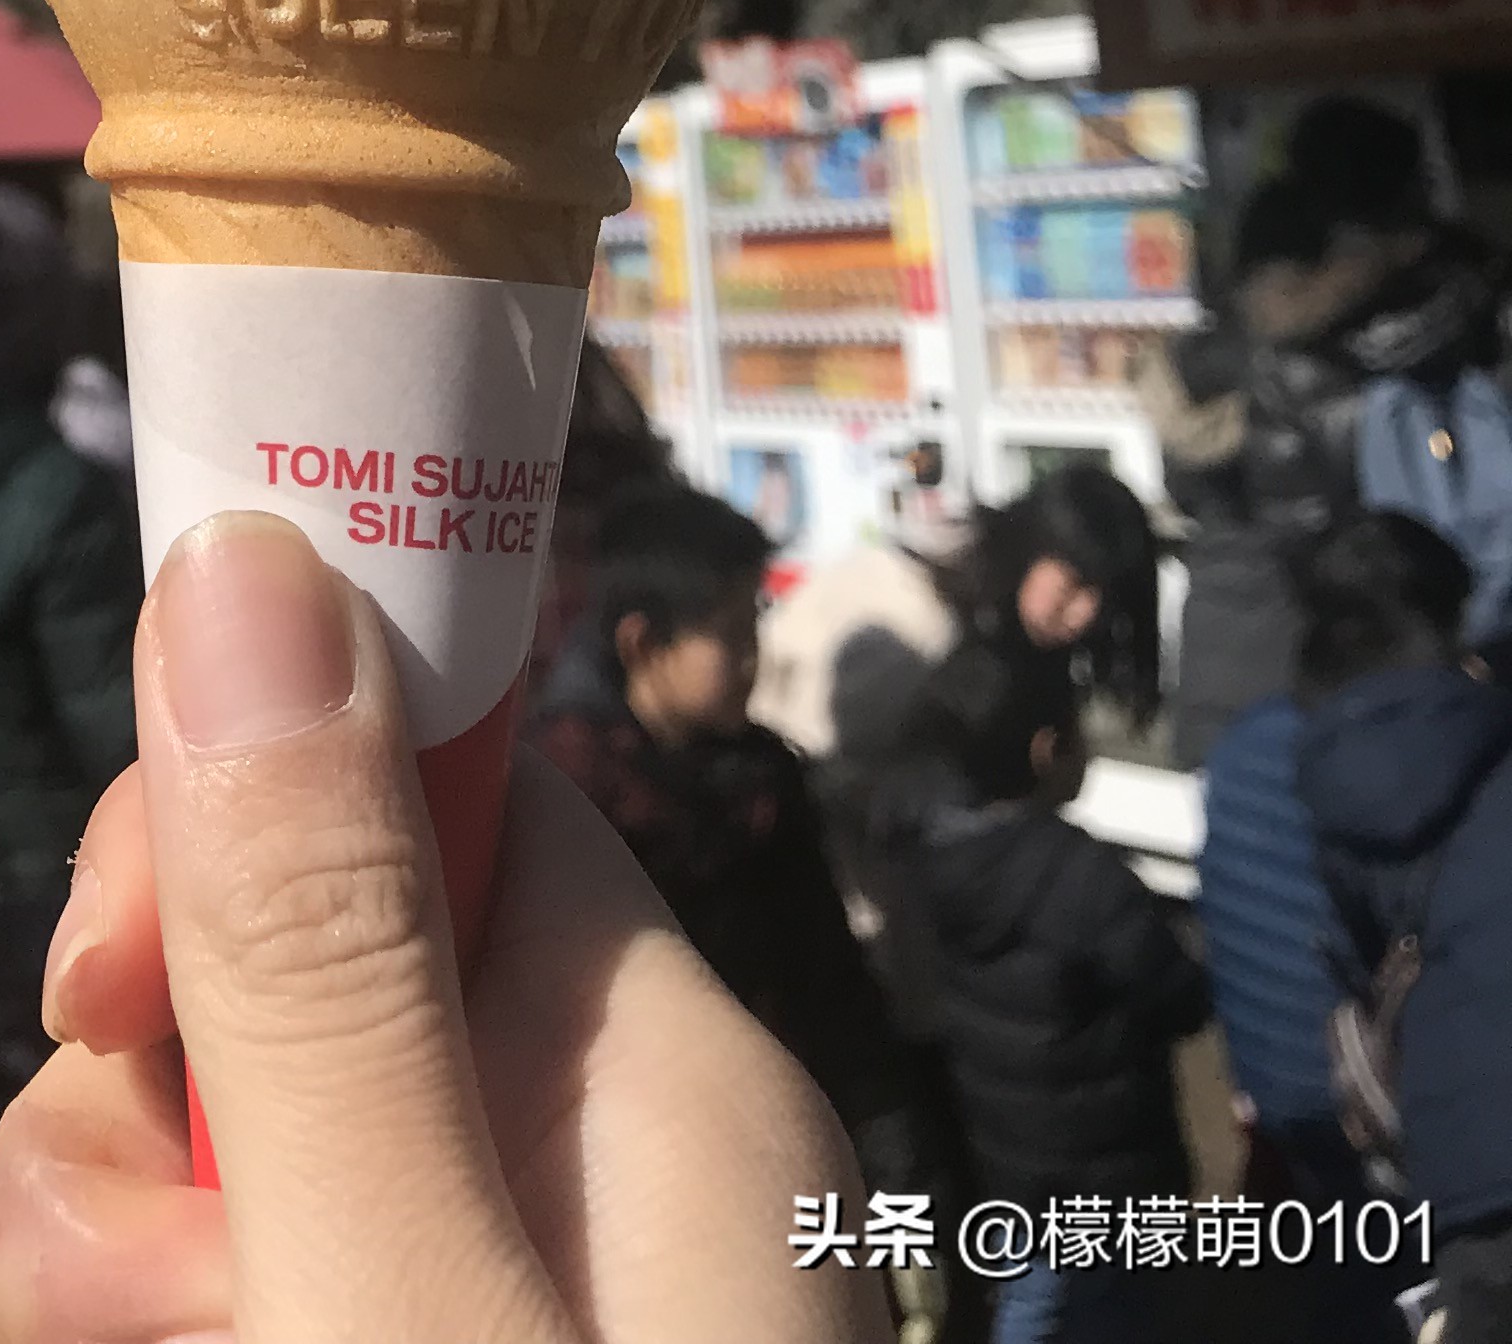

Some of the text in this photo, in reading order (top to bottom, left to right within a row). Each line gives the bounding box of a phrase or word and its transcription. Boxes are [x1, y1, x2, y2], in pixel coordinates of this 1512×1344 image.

[255, 442, 561, 503] TOMI SUJAHT
[347, 501, 539, 554] SILK ICE
